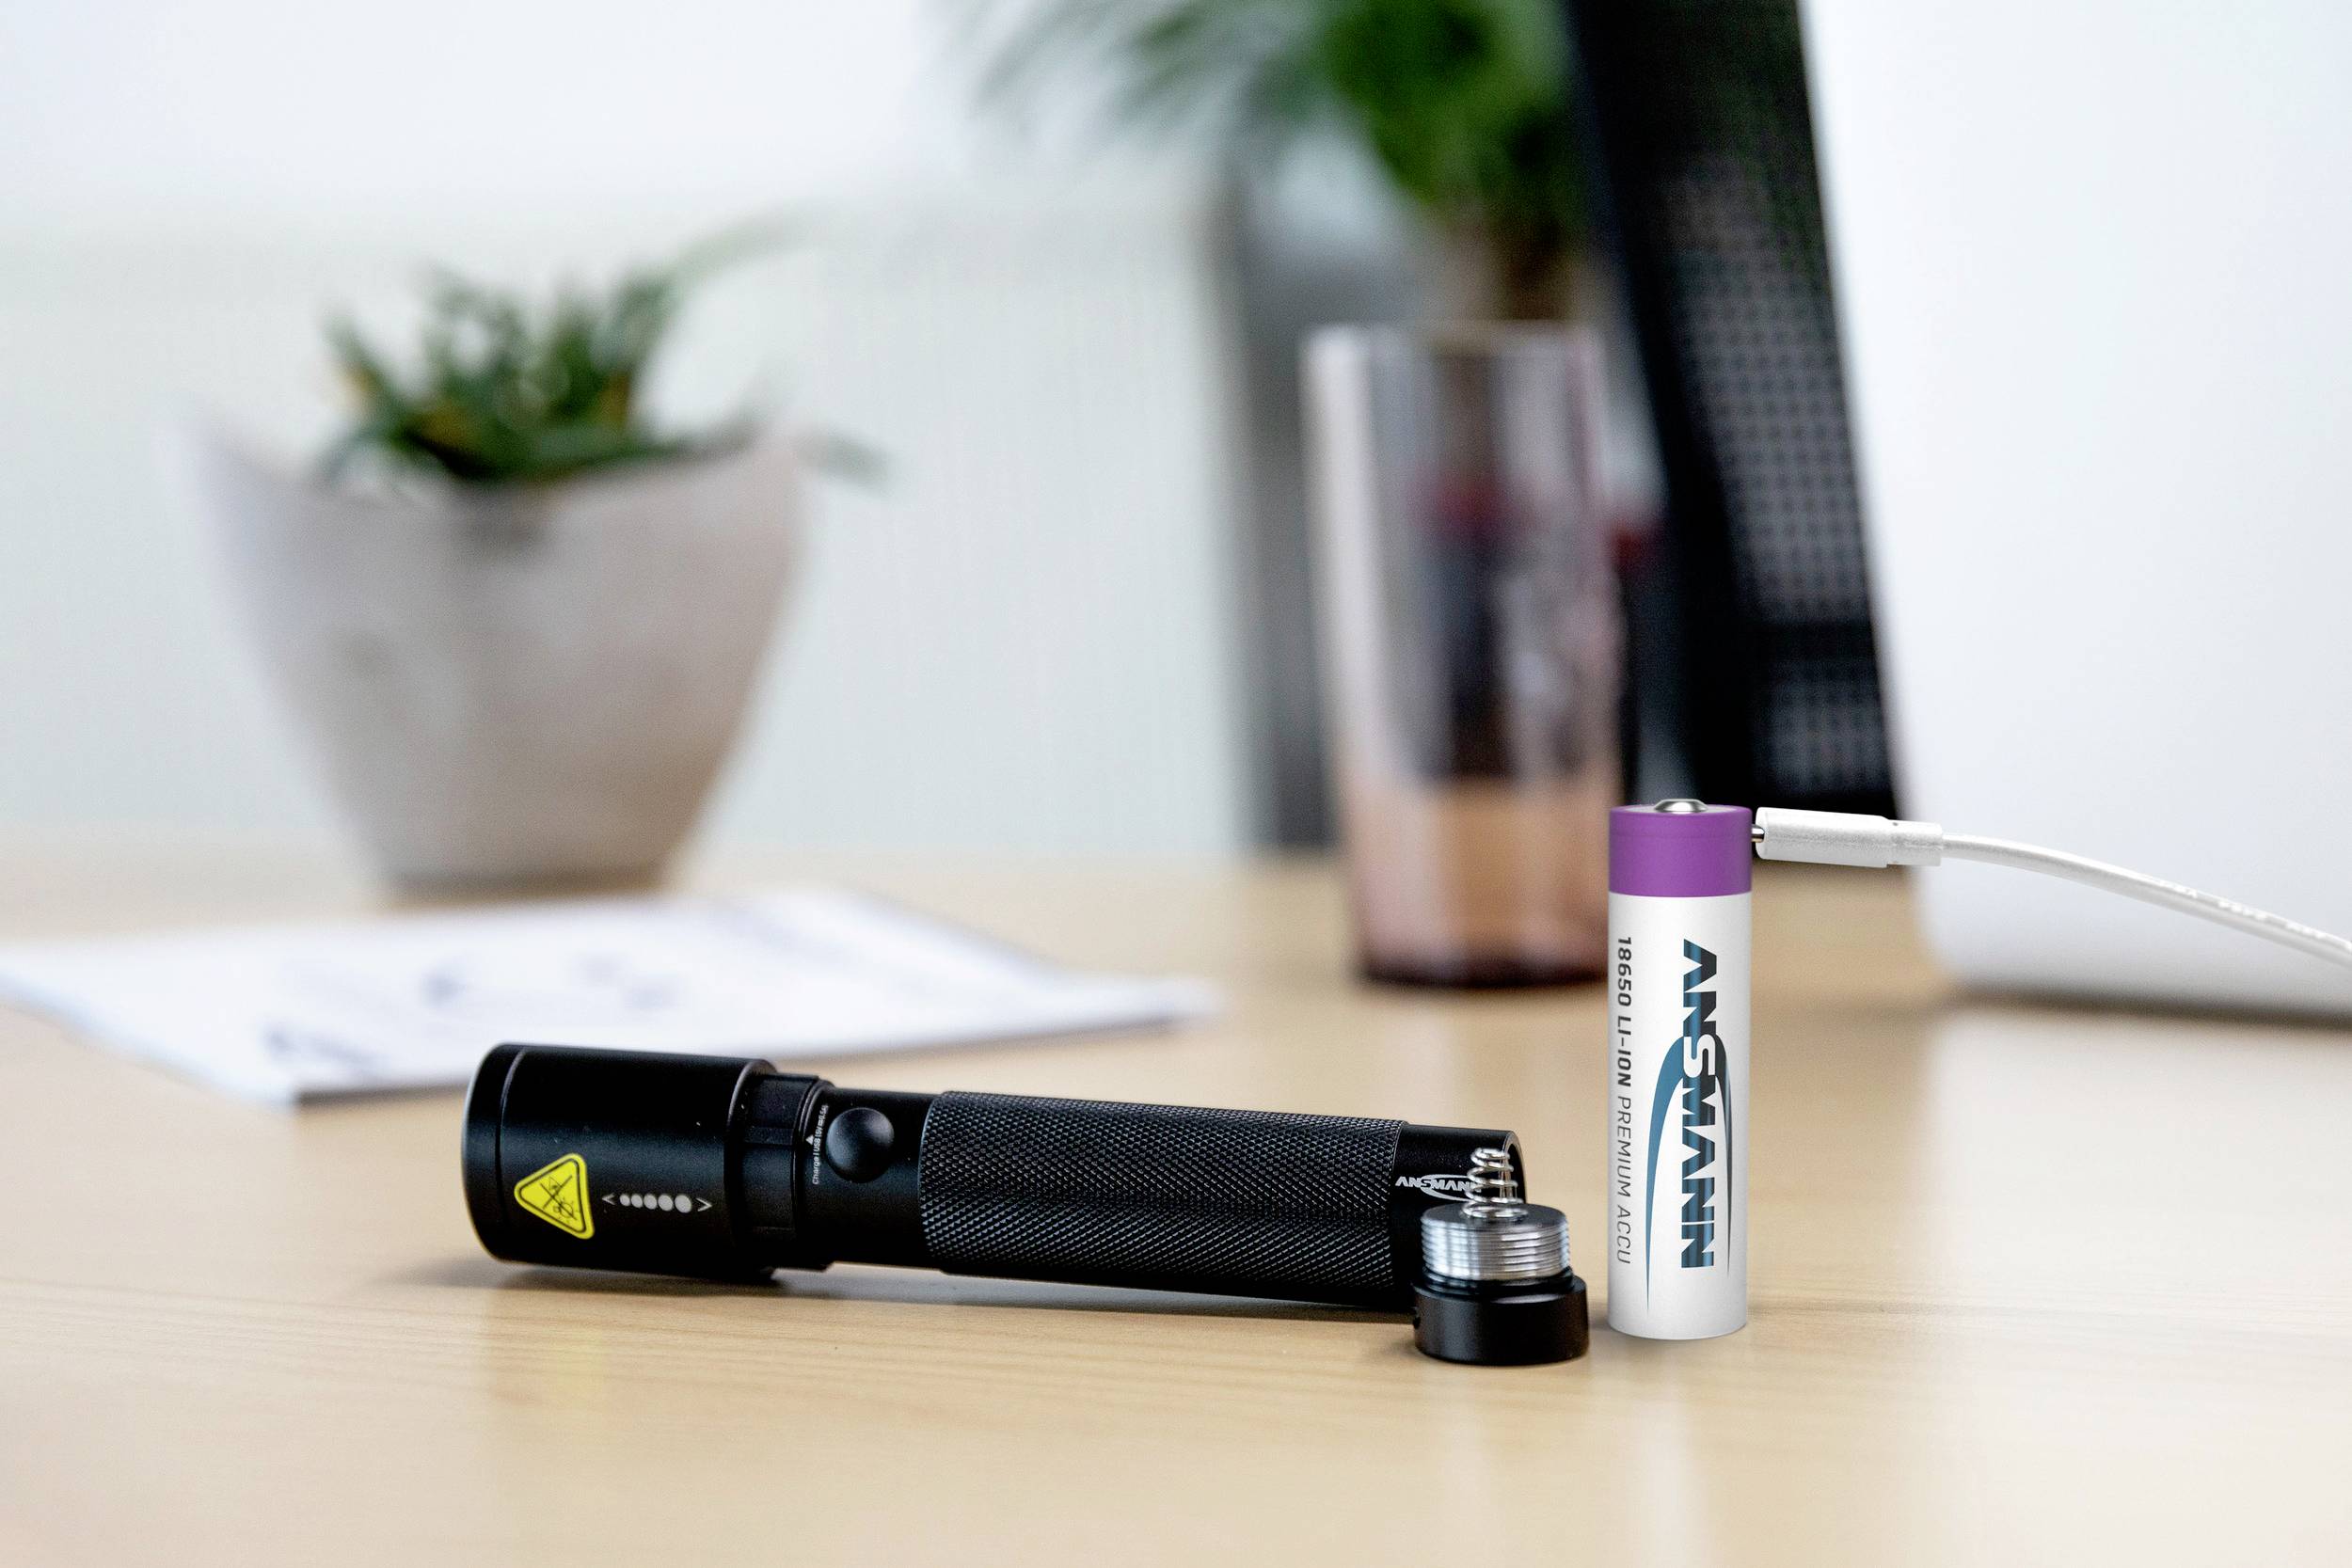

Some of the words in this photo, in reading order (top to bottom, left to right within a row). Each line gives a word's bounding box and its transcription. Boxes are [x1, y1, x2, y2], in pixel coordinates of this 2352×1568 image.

[1616, 936, 1632, 1007] 18650
[1616, 1015, 1632, 1087] LI-ION
[1680, 938, 1717, 1269] ANSMANN
[812, 1155, 821, 1185] Charge
[813, 1137, 821, 1151] USB
[1616, 1095, 1632, 1197] PREMIUM
[1616, 1204, 1631, 1264] ACCU
